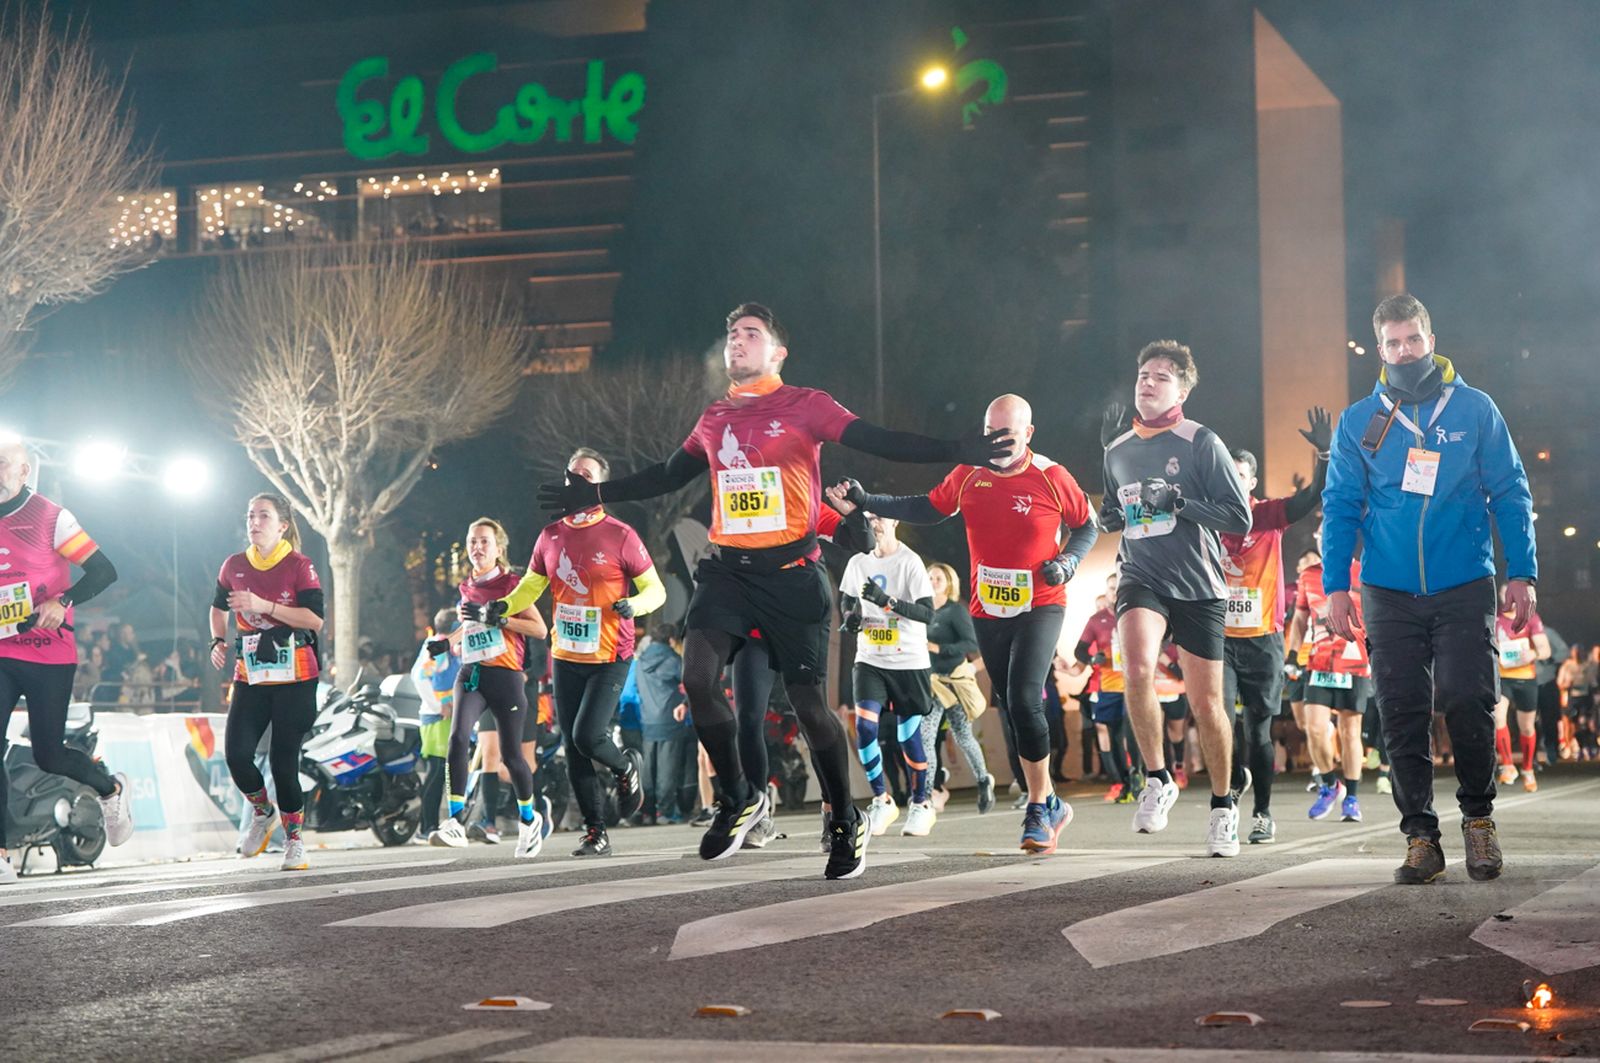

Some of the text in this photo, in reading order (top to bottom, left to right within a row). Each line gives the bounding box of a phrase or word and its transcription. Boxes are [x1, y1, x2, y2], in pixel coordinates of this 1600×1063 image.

[337, 52, 646, 160] El Corte
[730, 492, 768, 512] 3857
[988, 585, 1020, 602] 7756
[0, 602, 23, 621] 017
[562, 621, 589, 638] 7561
[468, 630, 494, 648] 8191
